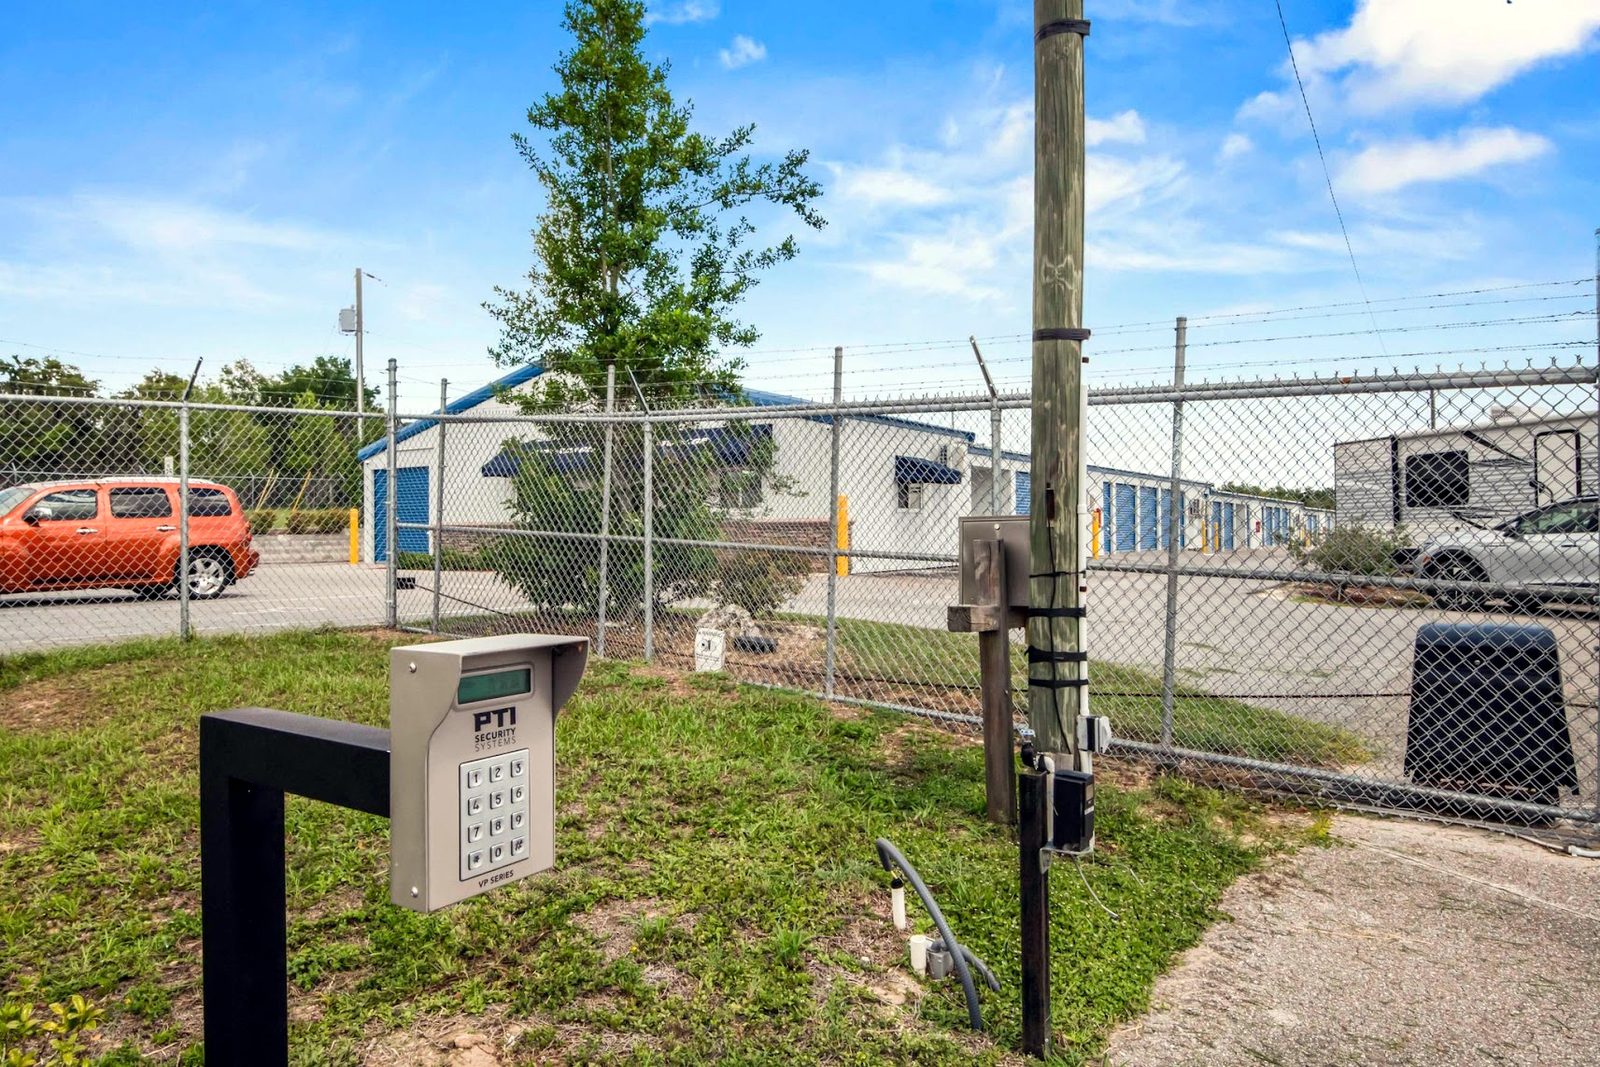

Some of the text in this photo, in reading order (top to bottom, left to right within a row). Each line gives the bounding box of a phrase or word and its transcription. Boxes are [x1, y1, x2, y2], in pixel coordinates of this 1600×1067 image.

[473, 706, 516, 732] PTI
[474, 727, 516, 743] SECURITY
[474, 736, 517, 752] SYSTEMS
[474, 763, 521, 783] 1 2 3
[472, 788, 522, 810] 4 5 6
[474, 814, 522, 838] 7 8 9
[514, 839, 523, 851] #
[478, 869, 514, 888] VP SERIES
